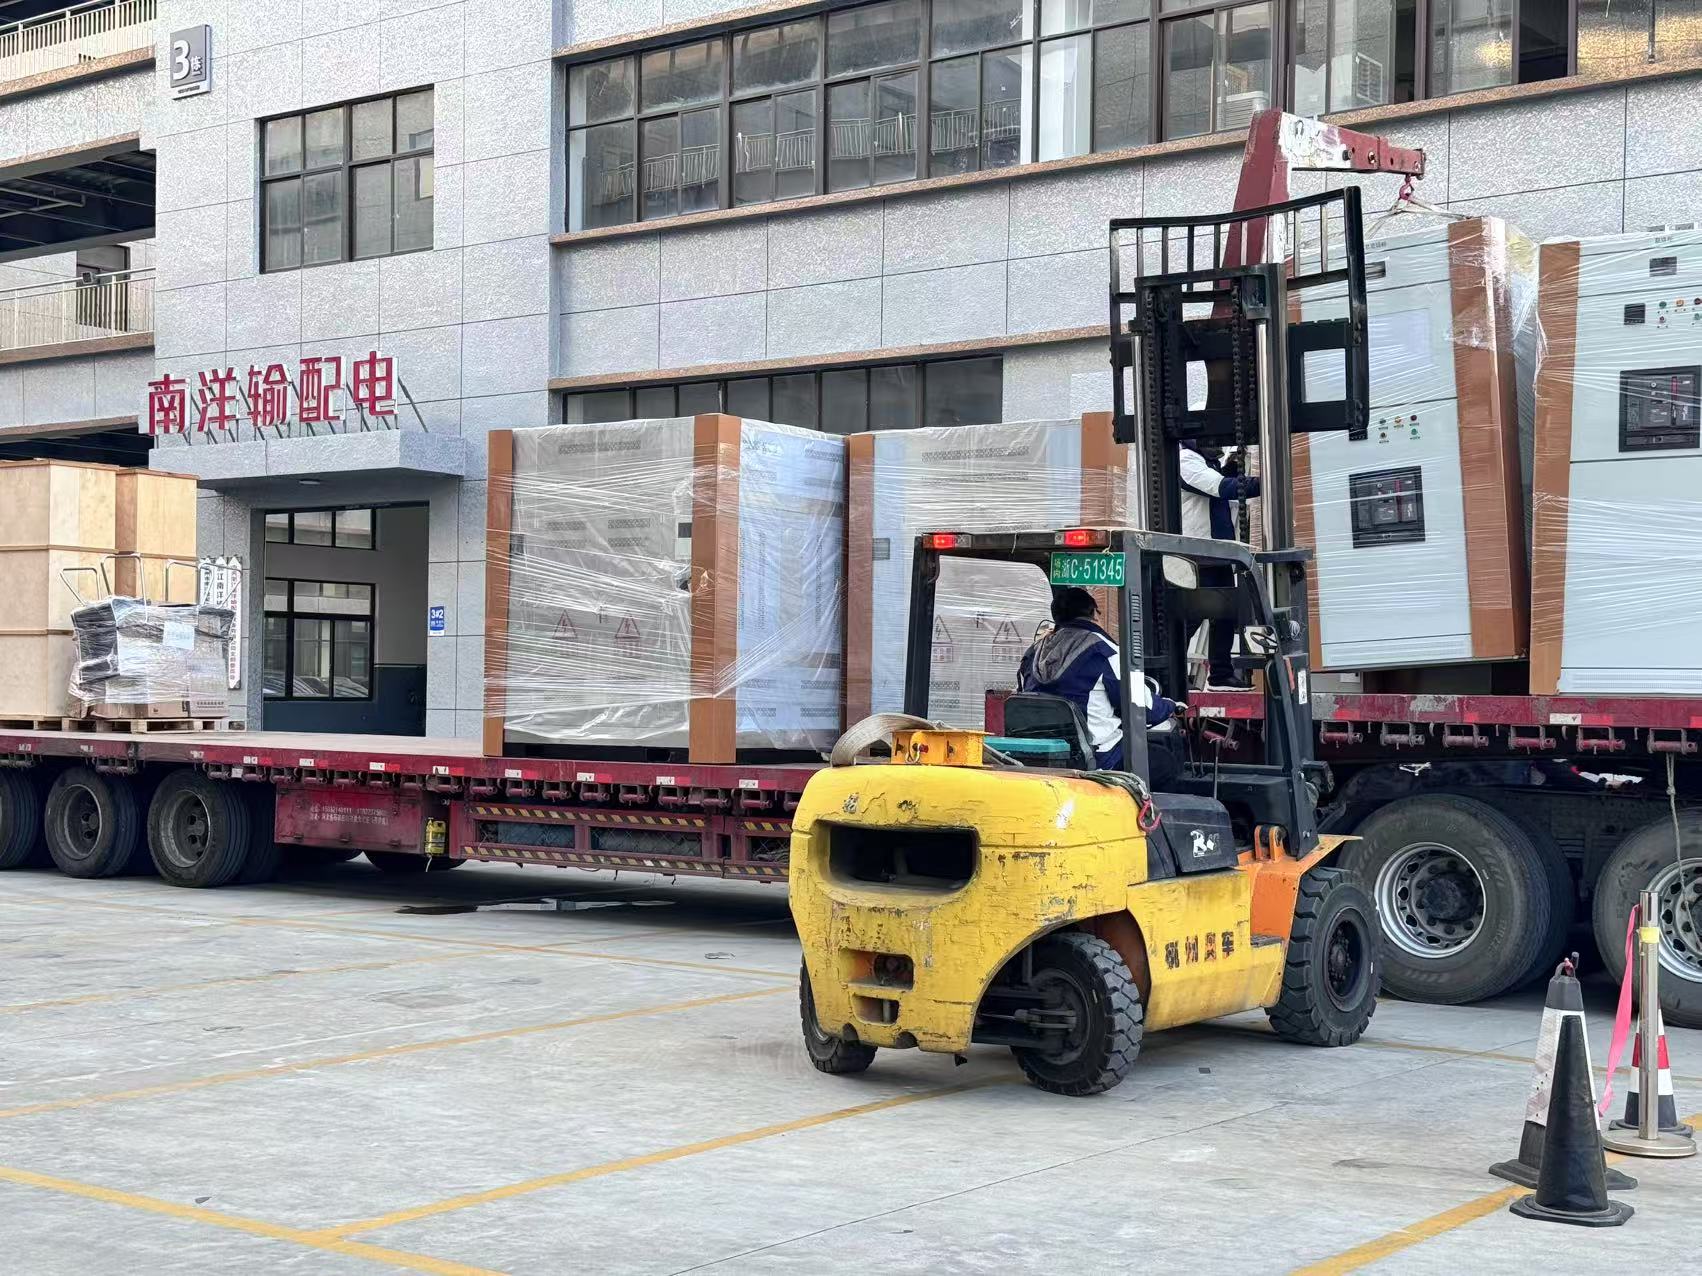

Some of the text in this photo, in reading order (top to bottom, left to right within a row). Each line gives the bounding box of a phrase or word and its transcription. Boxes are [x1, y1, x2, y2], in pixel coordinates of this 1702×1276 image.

[148, 350, 396, 435] 南洋输配电
